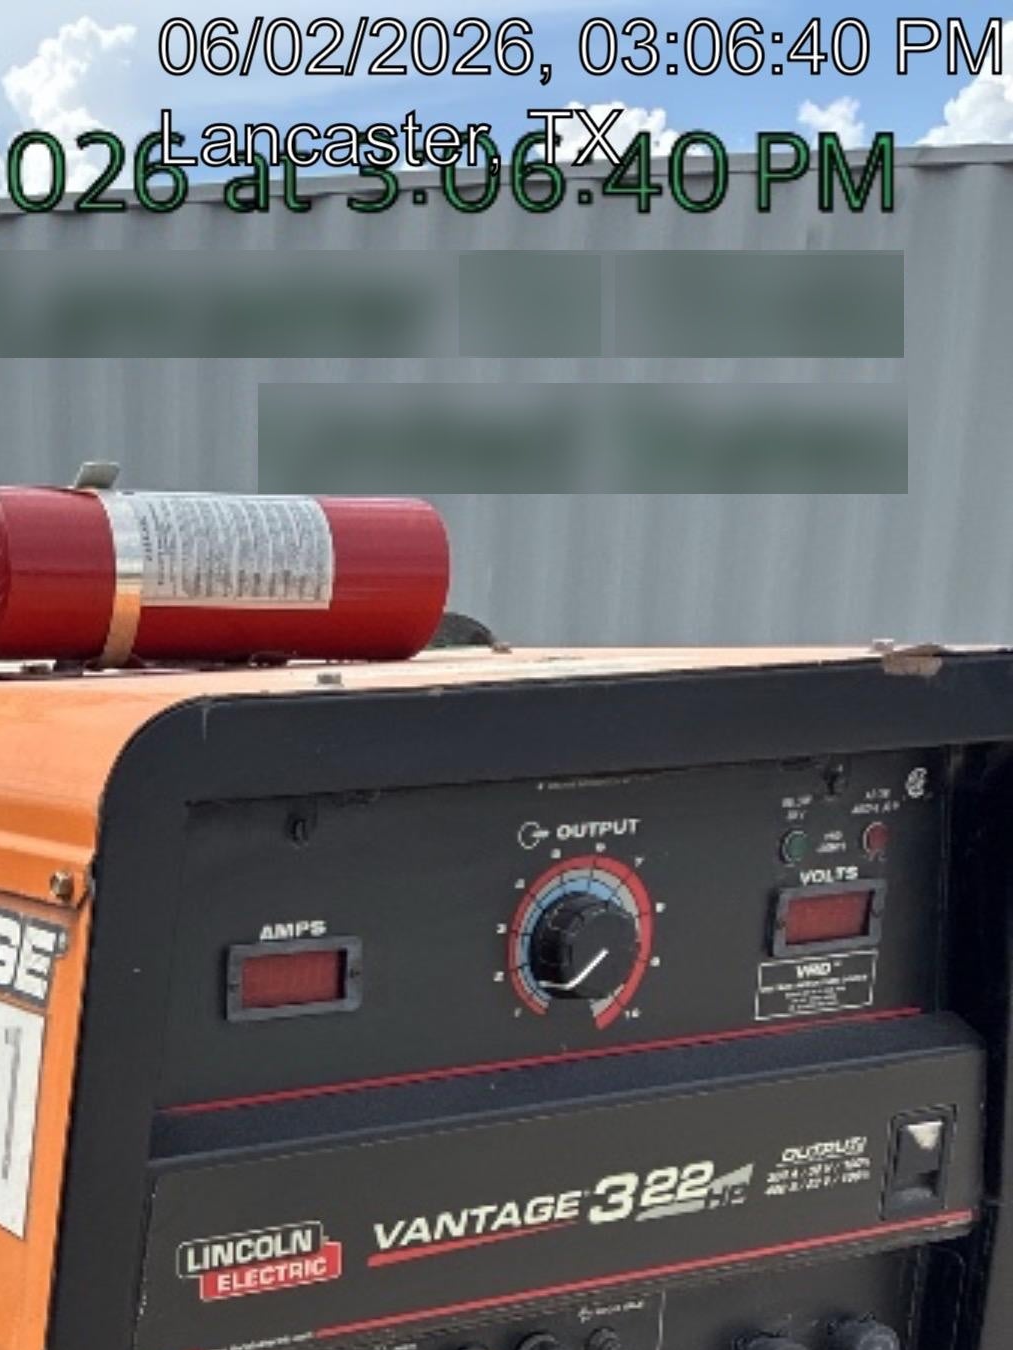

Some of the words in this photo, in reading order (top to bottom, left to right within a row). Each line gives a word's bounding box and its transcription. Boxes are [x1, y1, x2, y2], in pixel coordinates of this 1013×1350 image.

[556, 818, 641, 840] OUTPUT
[799, 866, 859, 886] VOLTS
[259, 920, 327, 941] AMPS
[373, 1190, 583, 1250] VANTAGE
[590, 1160, 714, 1225] 322
[187, 1229, 313, 1274] LINCOLN
[217, 1257, 328, 1293] ELECTRIC
